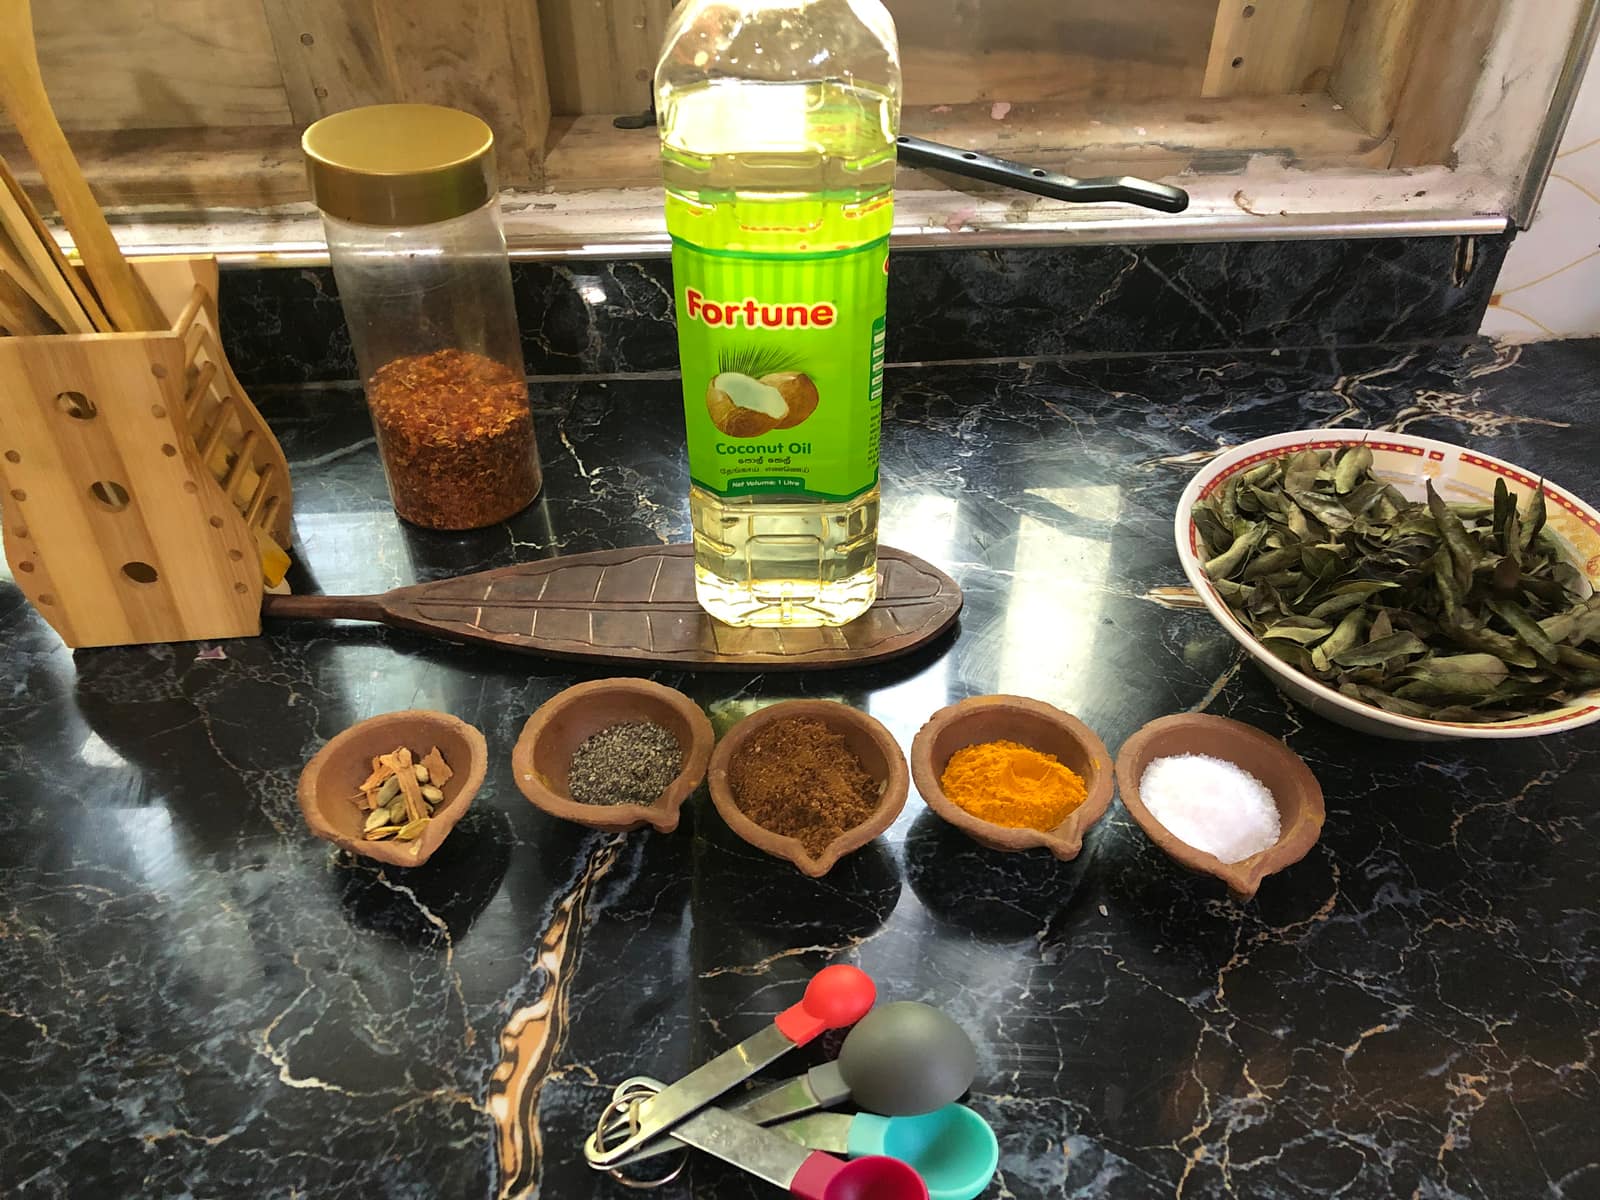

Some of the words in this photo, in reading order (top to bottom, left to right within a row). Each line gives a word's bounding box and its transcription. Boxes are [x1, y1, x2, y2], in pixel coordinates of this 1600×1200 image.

[686, 288, 834, 328] Fortune
[715, 442, 784, 455] Coconut
[788, 442, 811, 455] Oil
